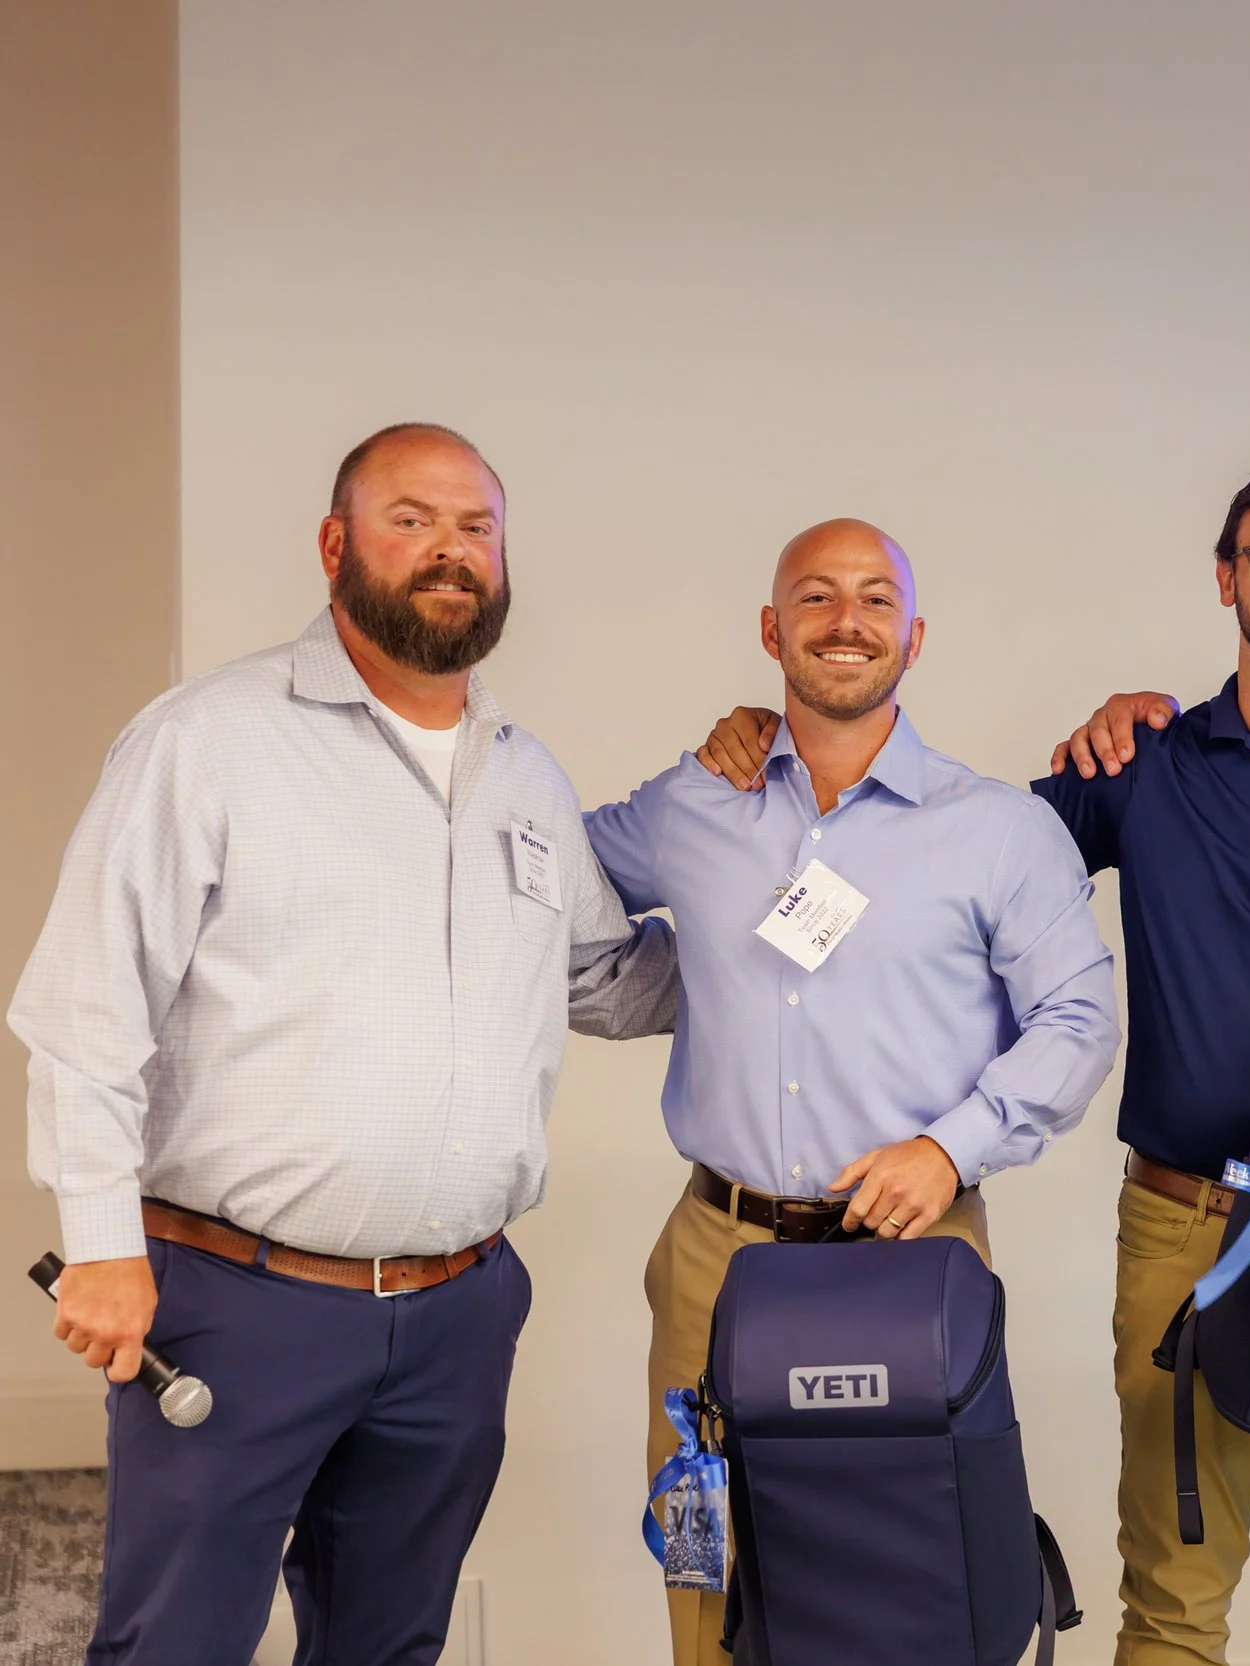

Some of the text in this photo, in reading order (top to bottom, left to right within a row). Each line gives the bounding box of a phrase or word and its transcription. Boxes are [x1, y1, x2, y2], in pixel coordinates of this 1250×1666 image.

[519, 830, 549, 855] Warren
[778, 886, 808, 918] Luke
[794, 901, 813, 920] Pope
[811, 929, 830, 953] 50
[797, 1374, 879, 1401] YETI
